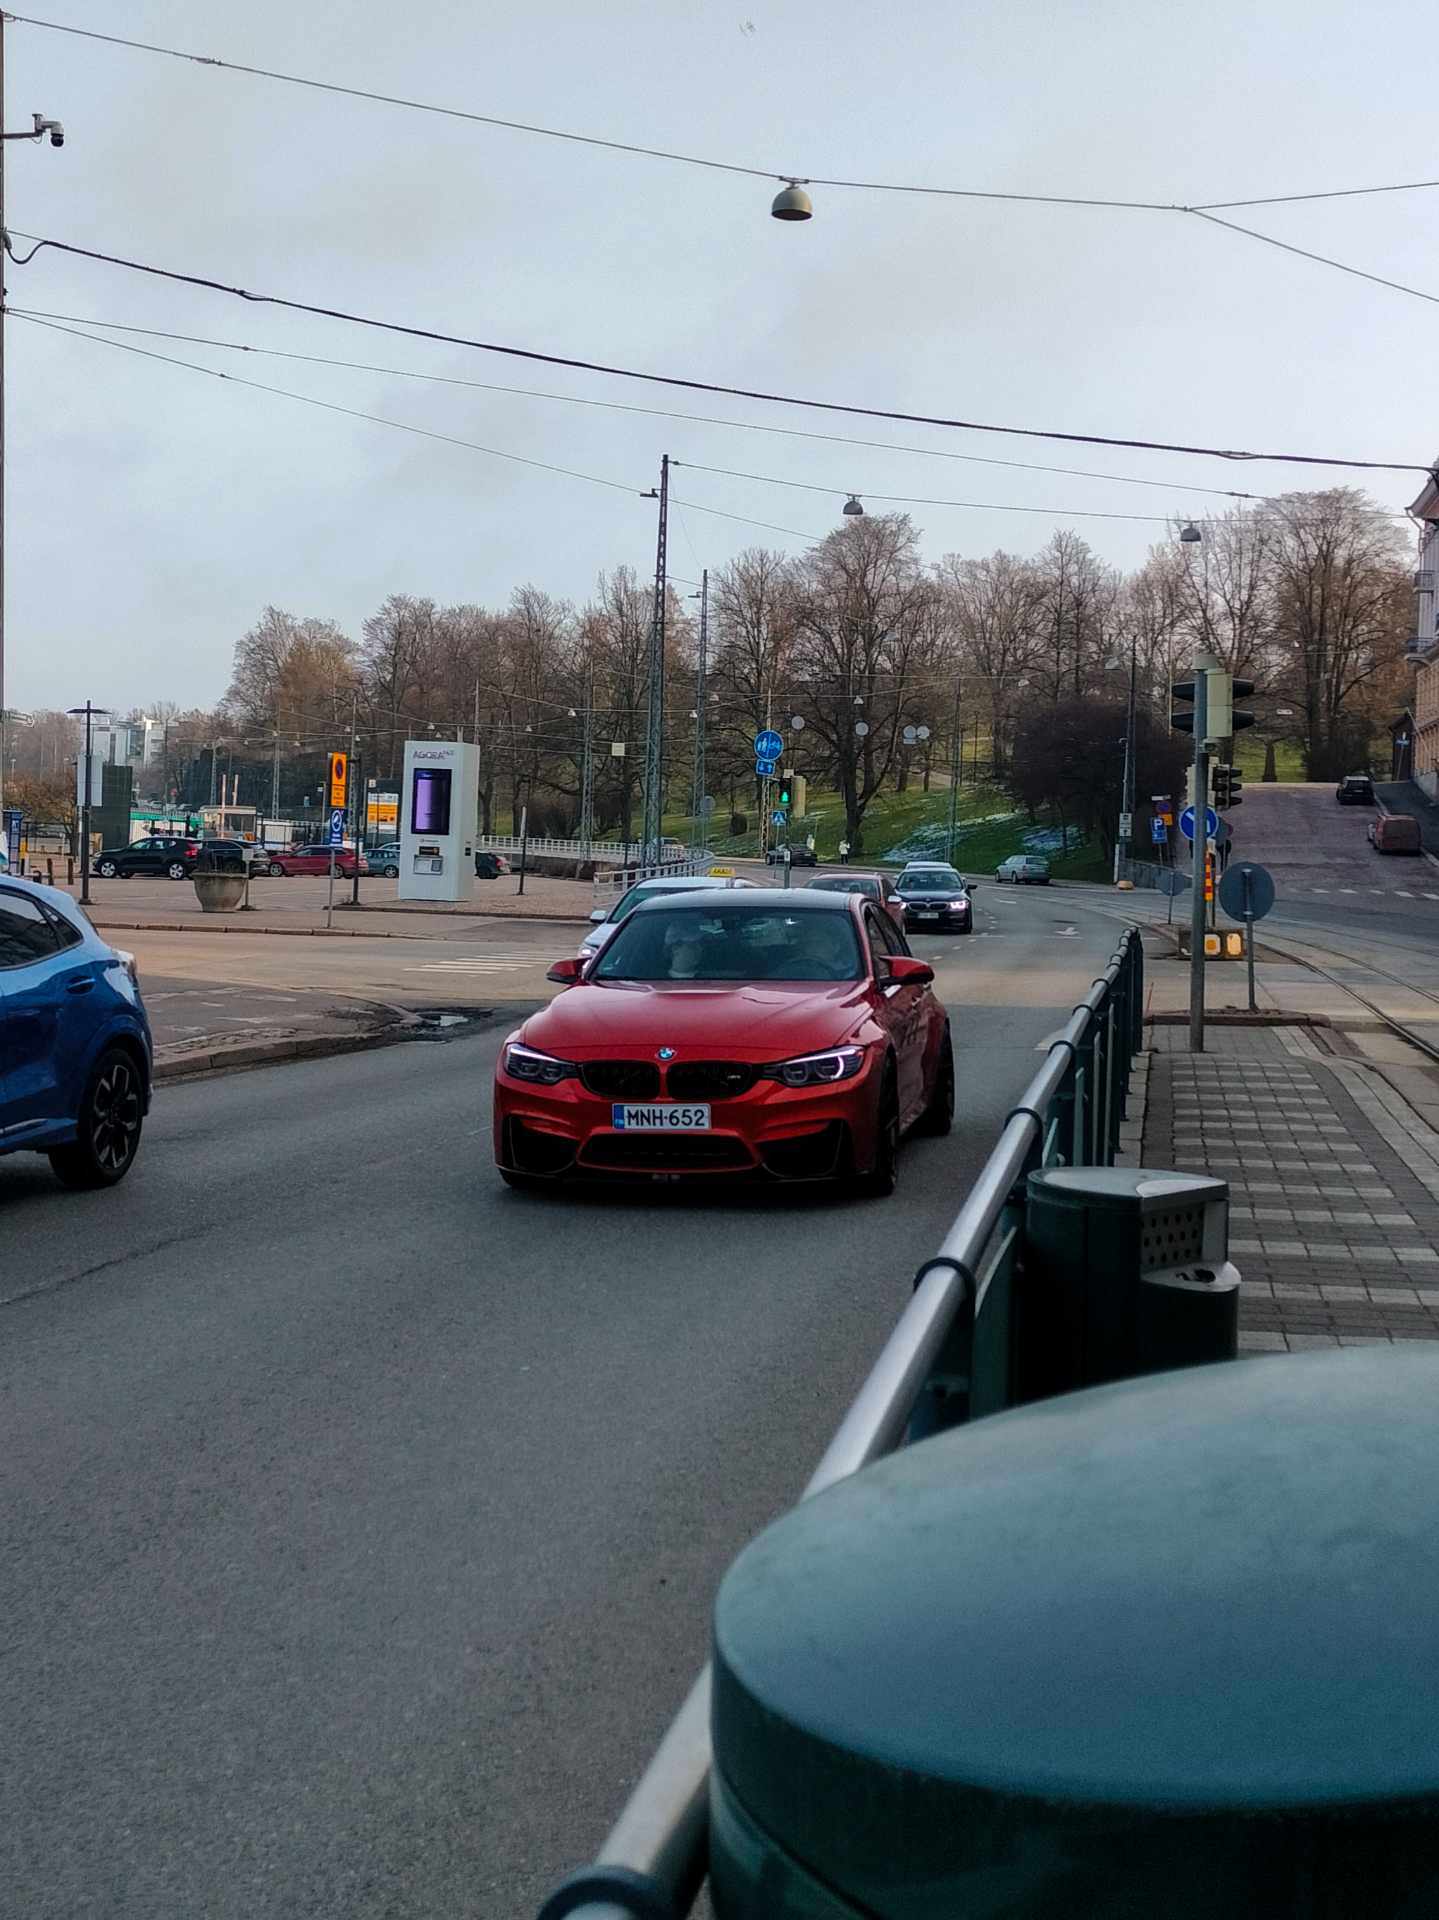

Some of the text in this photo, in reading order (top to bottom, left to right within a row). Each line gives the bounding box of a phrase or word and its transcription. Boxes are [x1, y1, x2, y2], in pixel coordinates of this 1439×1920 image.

[368, 779, 377, 788] B
[1153, 818, 1163, 831] P
[626, 1108, 706, 1127] MNH-652
